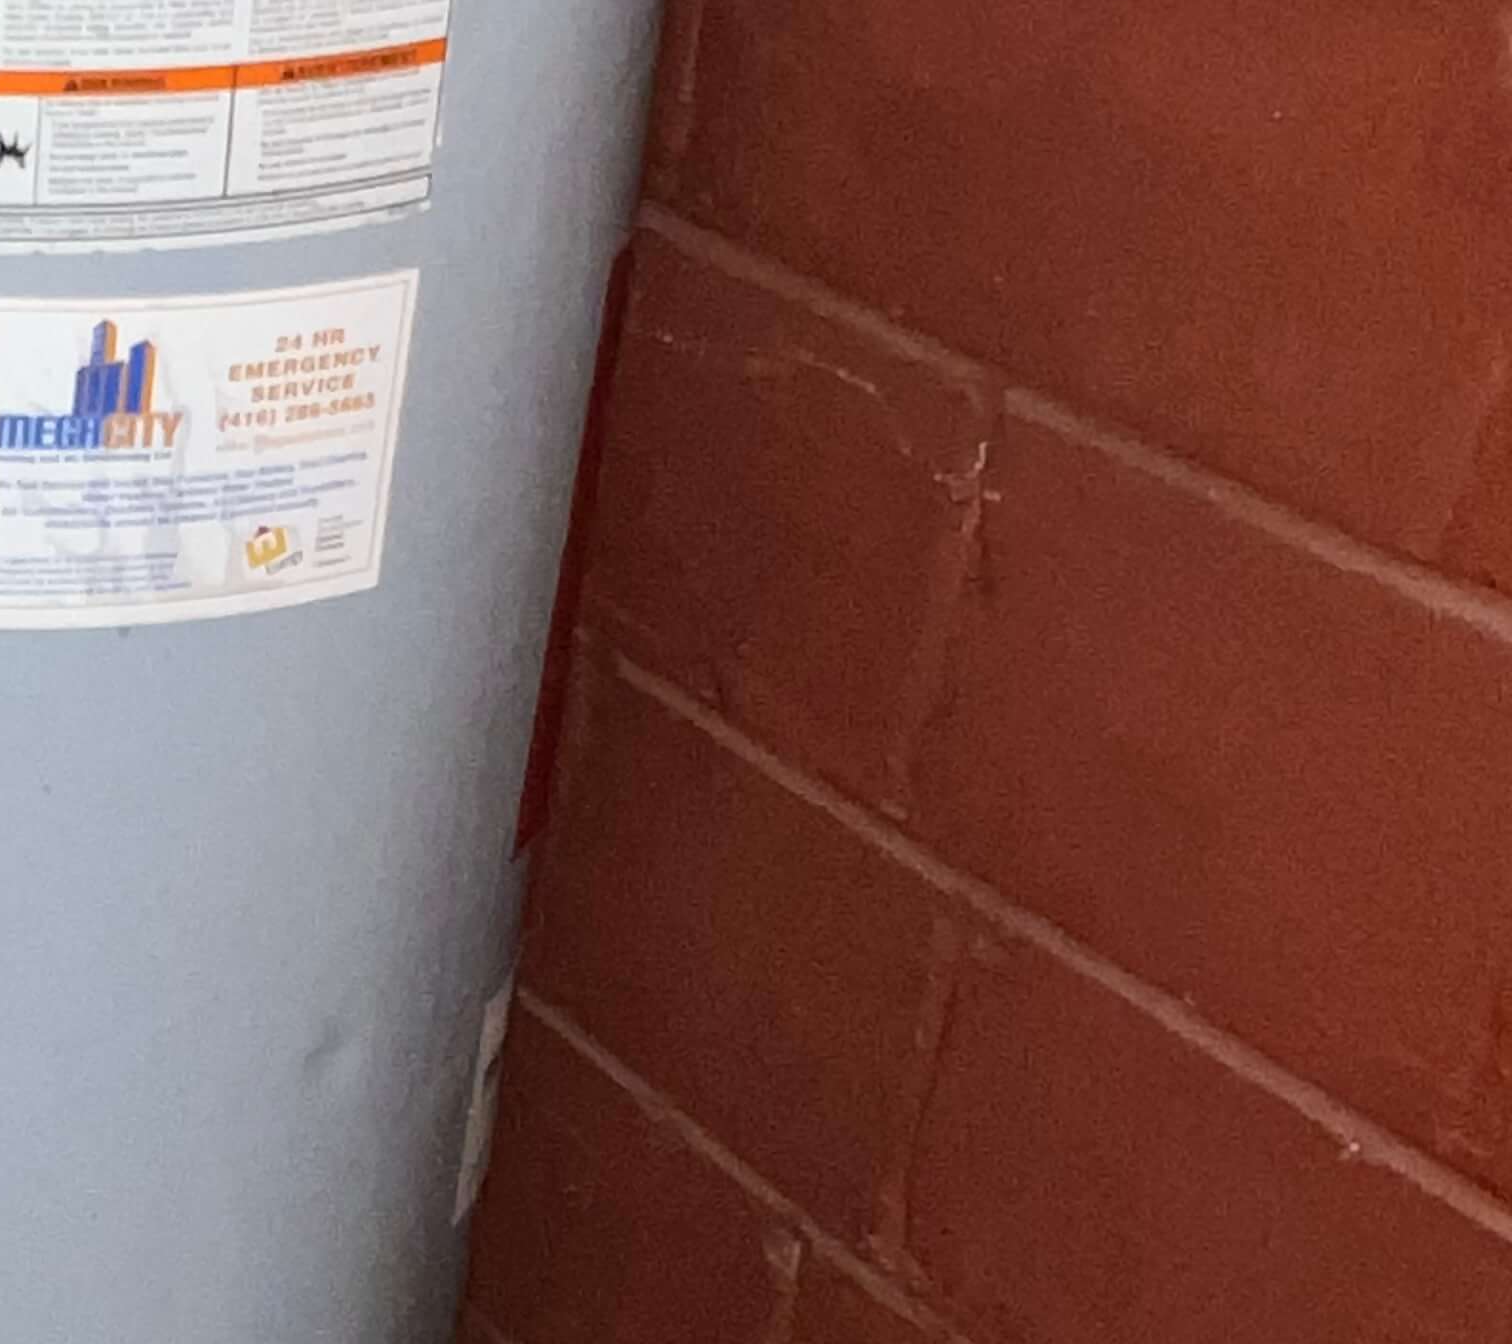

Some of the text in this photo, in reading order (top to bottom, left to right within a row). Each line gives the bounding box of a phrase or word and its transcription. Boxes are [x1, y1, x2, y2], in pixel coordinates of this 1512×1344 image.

[275, 328, 345, 353] 24 HR
[228, 343, 381, 382] EMERGENCY
[251, 372, 357, 403] SERVICE
